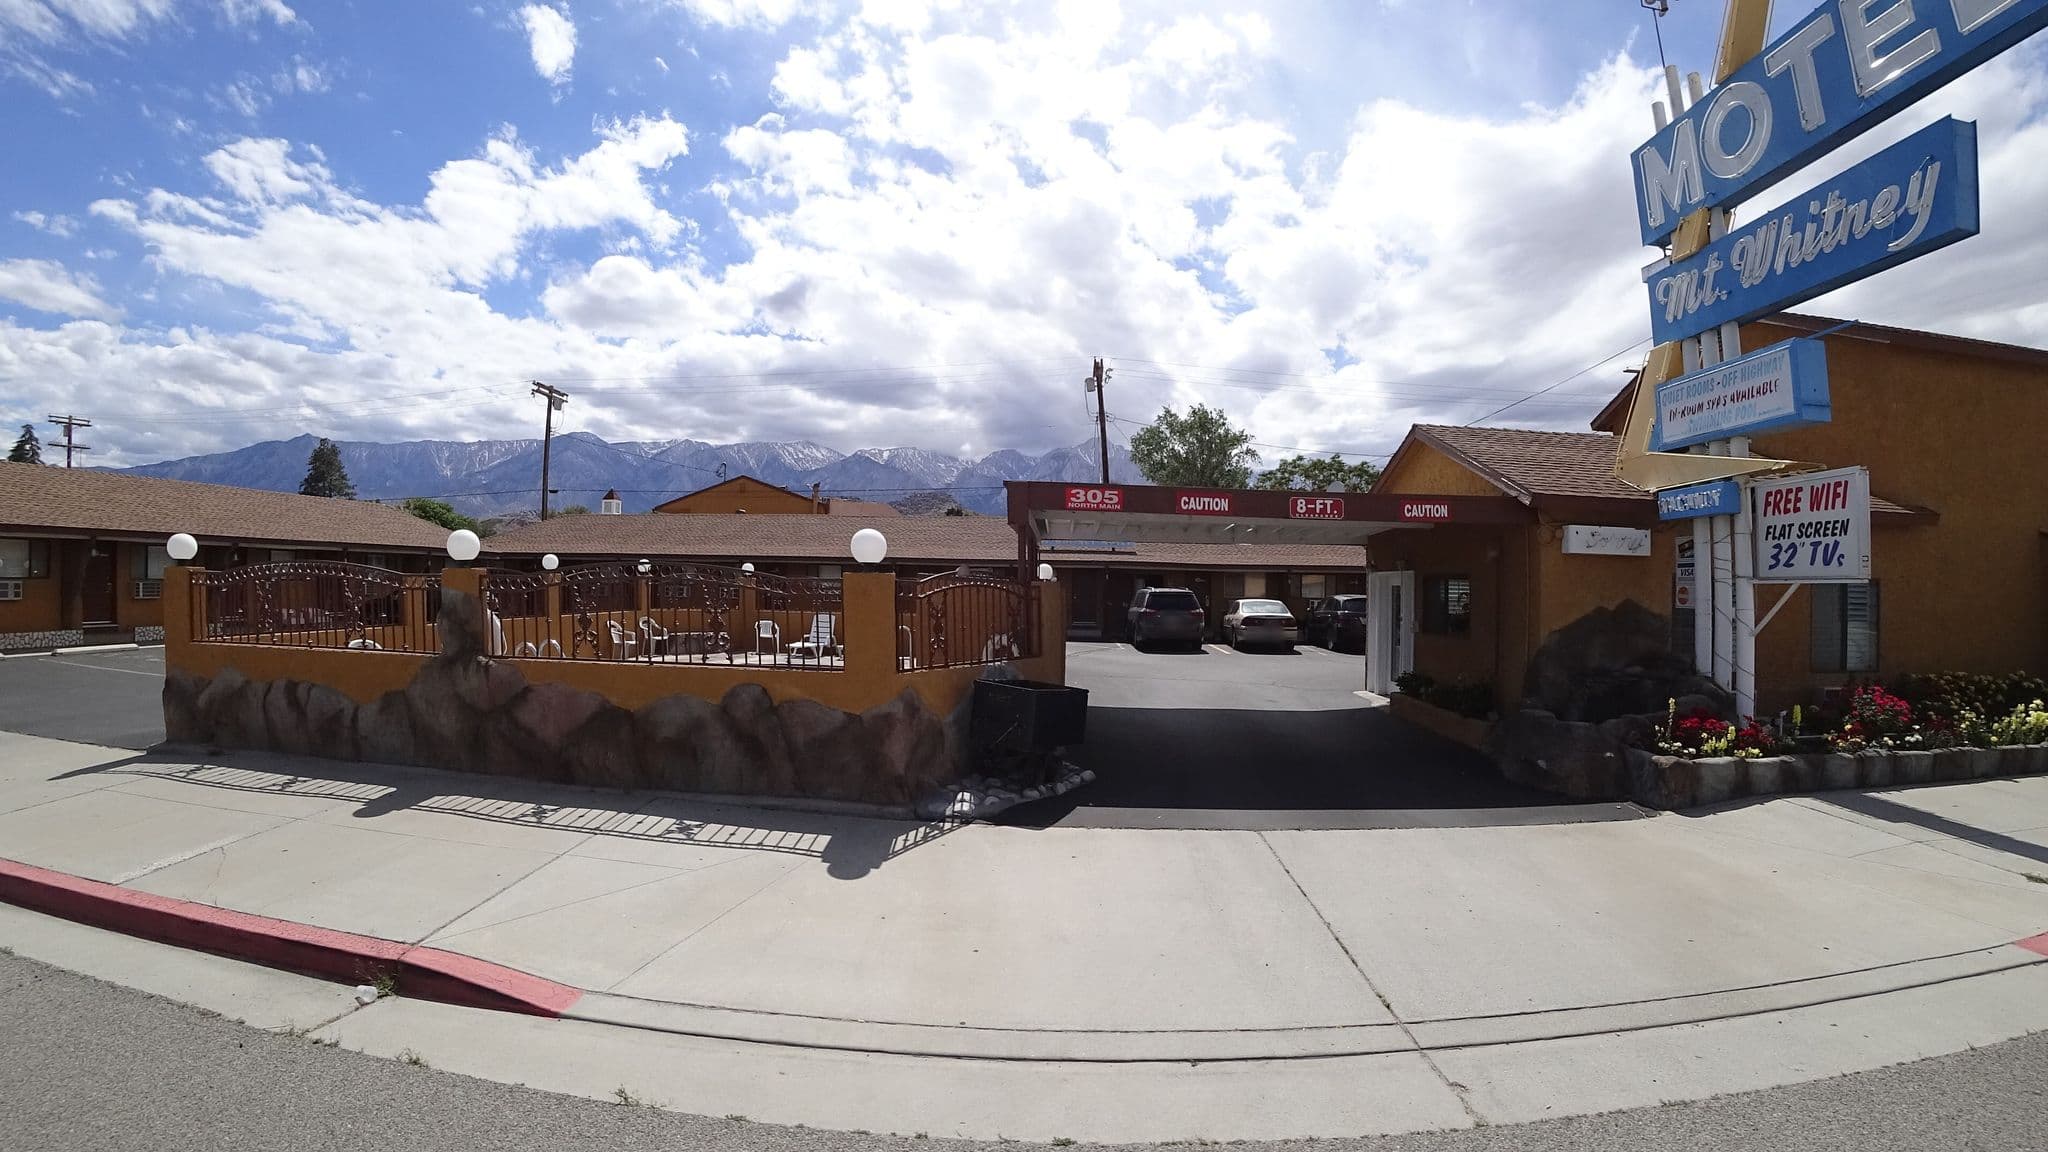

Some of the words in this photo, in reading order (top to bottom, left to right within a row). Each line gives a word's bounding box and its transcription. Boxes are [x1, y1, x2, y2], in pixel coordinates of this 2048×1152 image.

[1655, 249, 1729, 323] Mt.
[1731, 155, 1941, 288] Whitney
[1662, 387, 1684, 407] QUIET
[1686, 377, 1715, 400] ROOMS
[1721, 370, 1738, 389] OFF
[1740, 353, 1785, 382] HIGHWAY
[1730, 378, 1780, 404] AVAILABLE
[1070, 489, 1119, 504] 305
[1180, 496, 1229, 511] CAUTION
[1763, 486, 1803, 517] FREE
[1809, 480, 1849, 512] WIFI
[1404, 504, 1448, 518] CAUTION
[1765, 523, 1795, 541] FLAT
[1796, 518, 1850, 539] SCREEN
[1809, 539, 1845, 567] TVs
[1680, 568, 1694, 577] VISA
